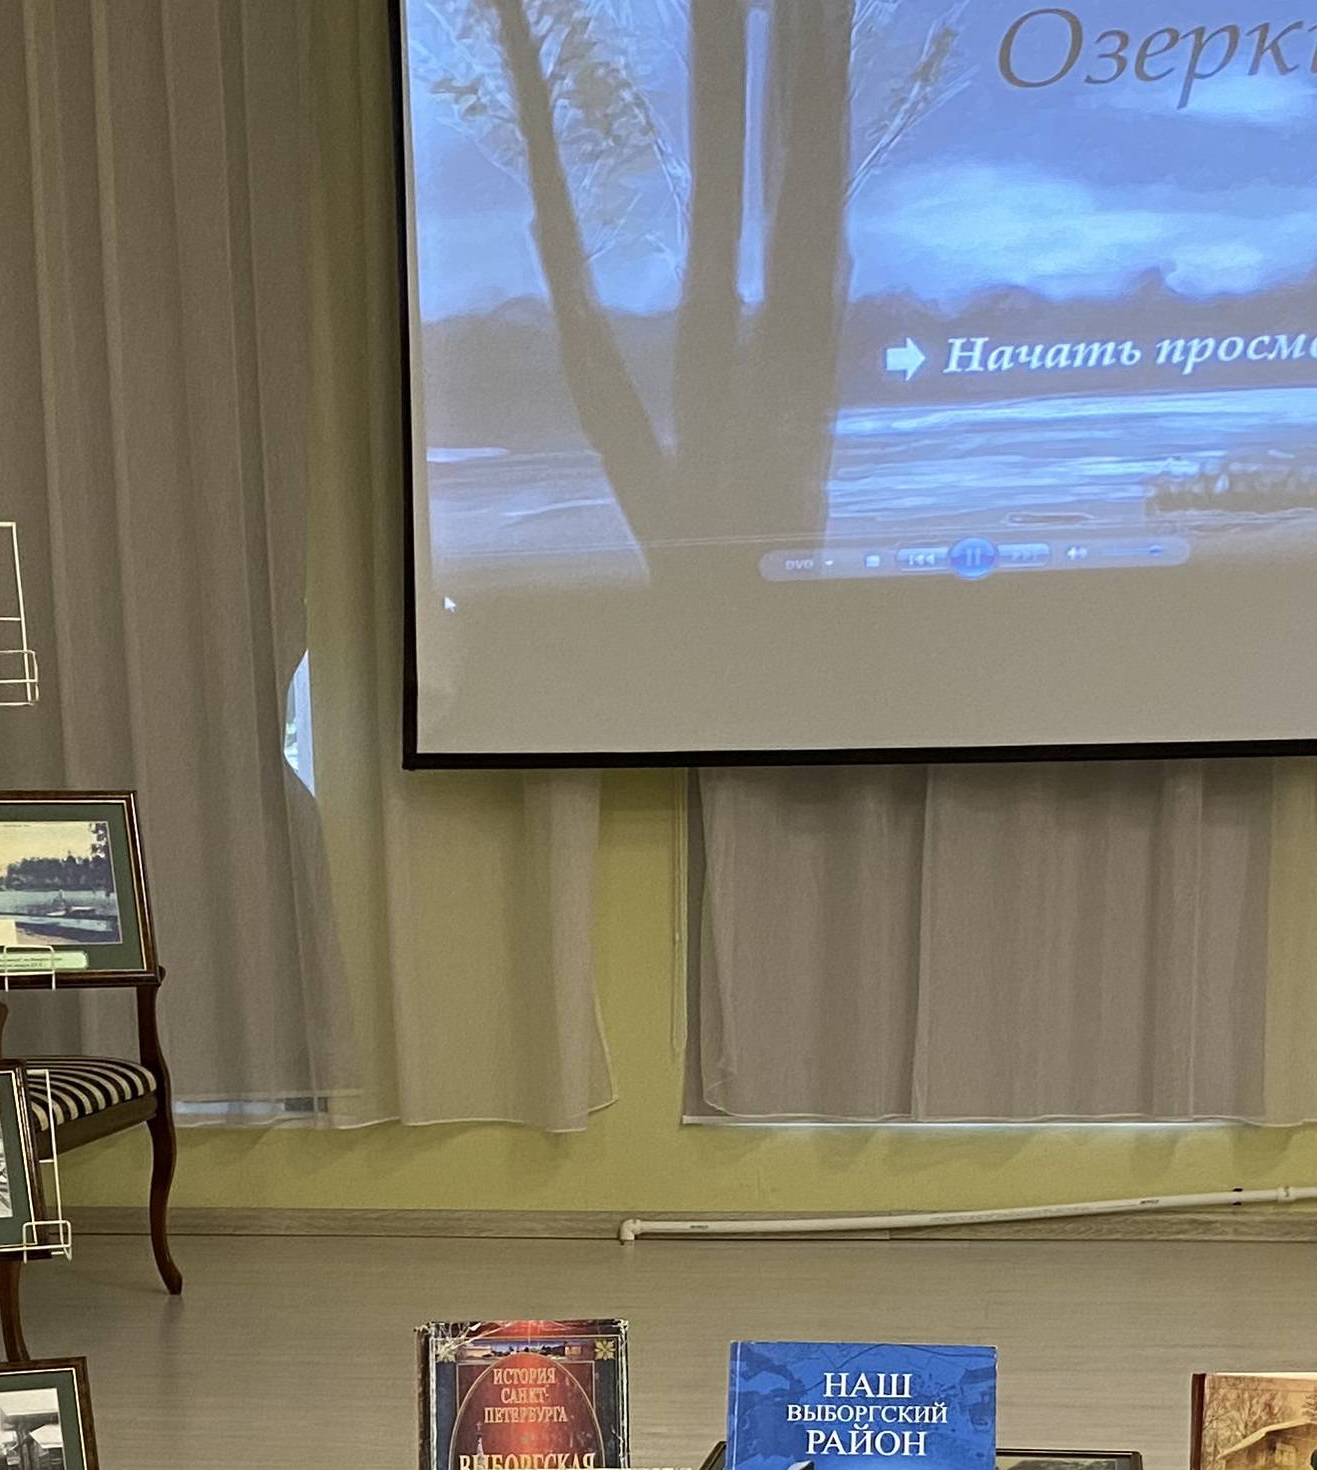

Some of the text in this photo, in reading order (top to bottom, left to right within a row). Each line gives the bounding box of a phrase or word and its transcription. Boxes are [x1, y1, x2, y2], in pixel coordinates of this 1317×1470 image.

[943, 334, 1142, 376] Начать
[493, 1367, 556, 1386] ИСТОРИЯ
[823, 1371, 913, 1400] НАШ
[500, 1387, 550, 1404] САНКТ-
[484, 1405, 569, 1424] ПЕТЕРБУРГА
[786, 1401, 949, 1426] ВЫБОРГСКИЙ
[805, 1423, 927, 1458] РАЙОН
